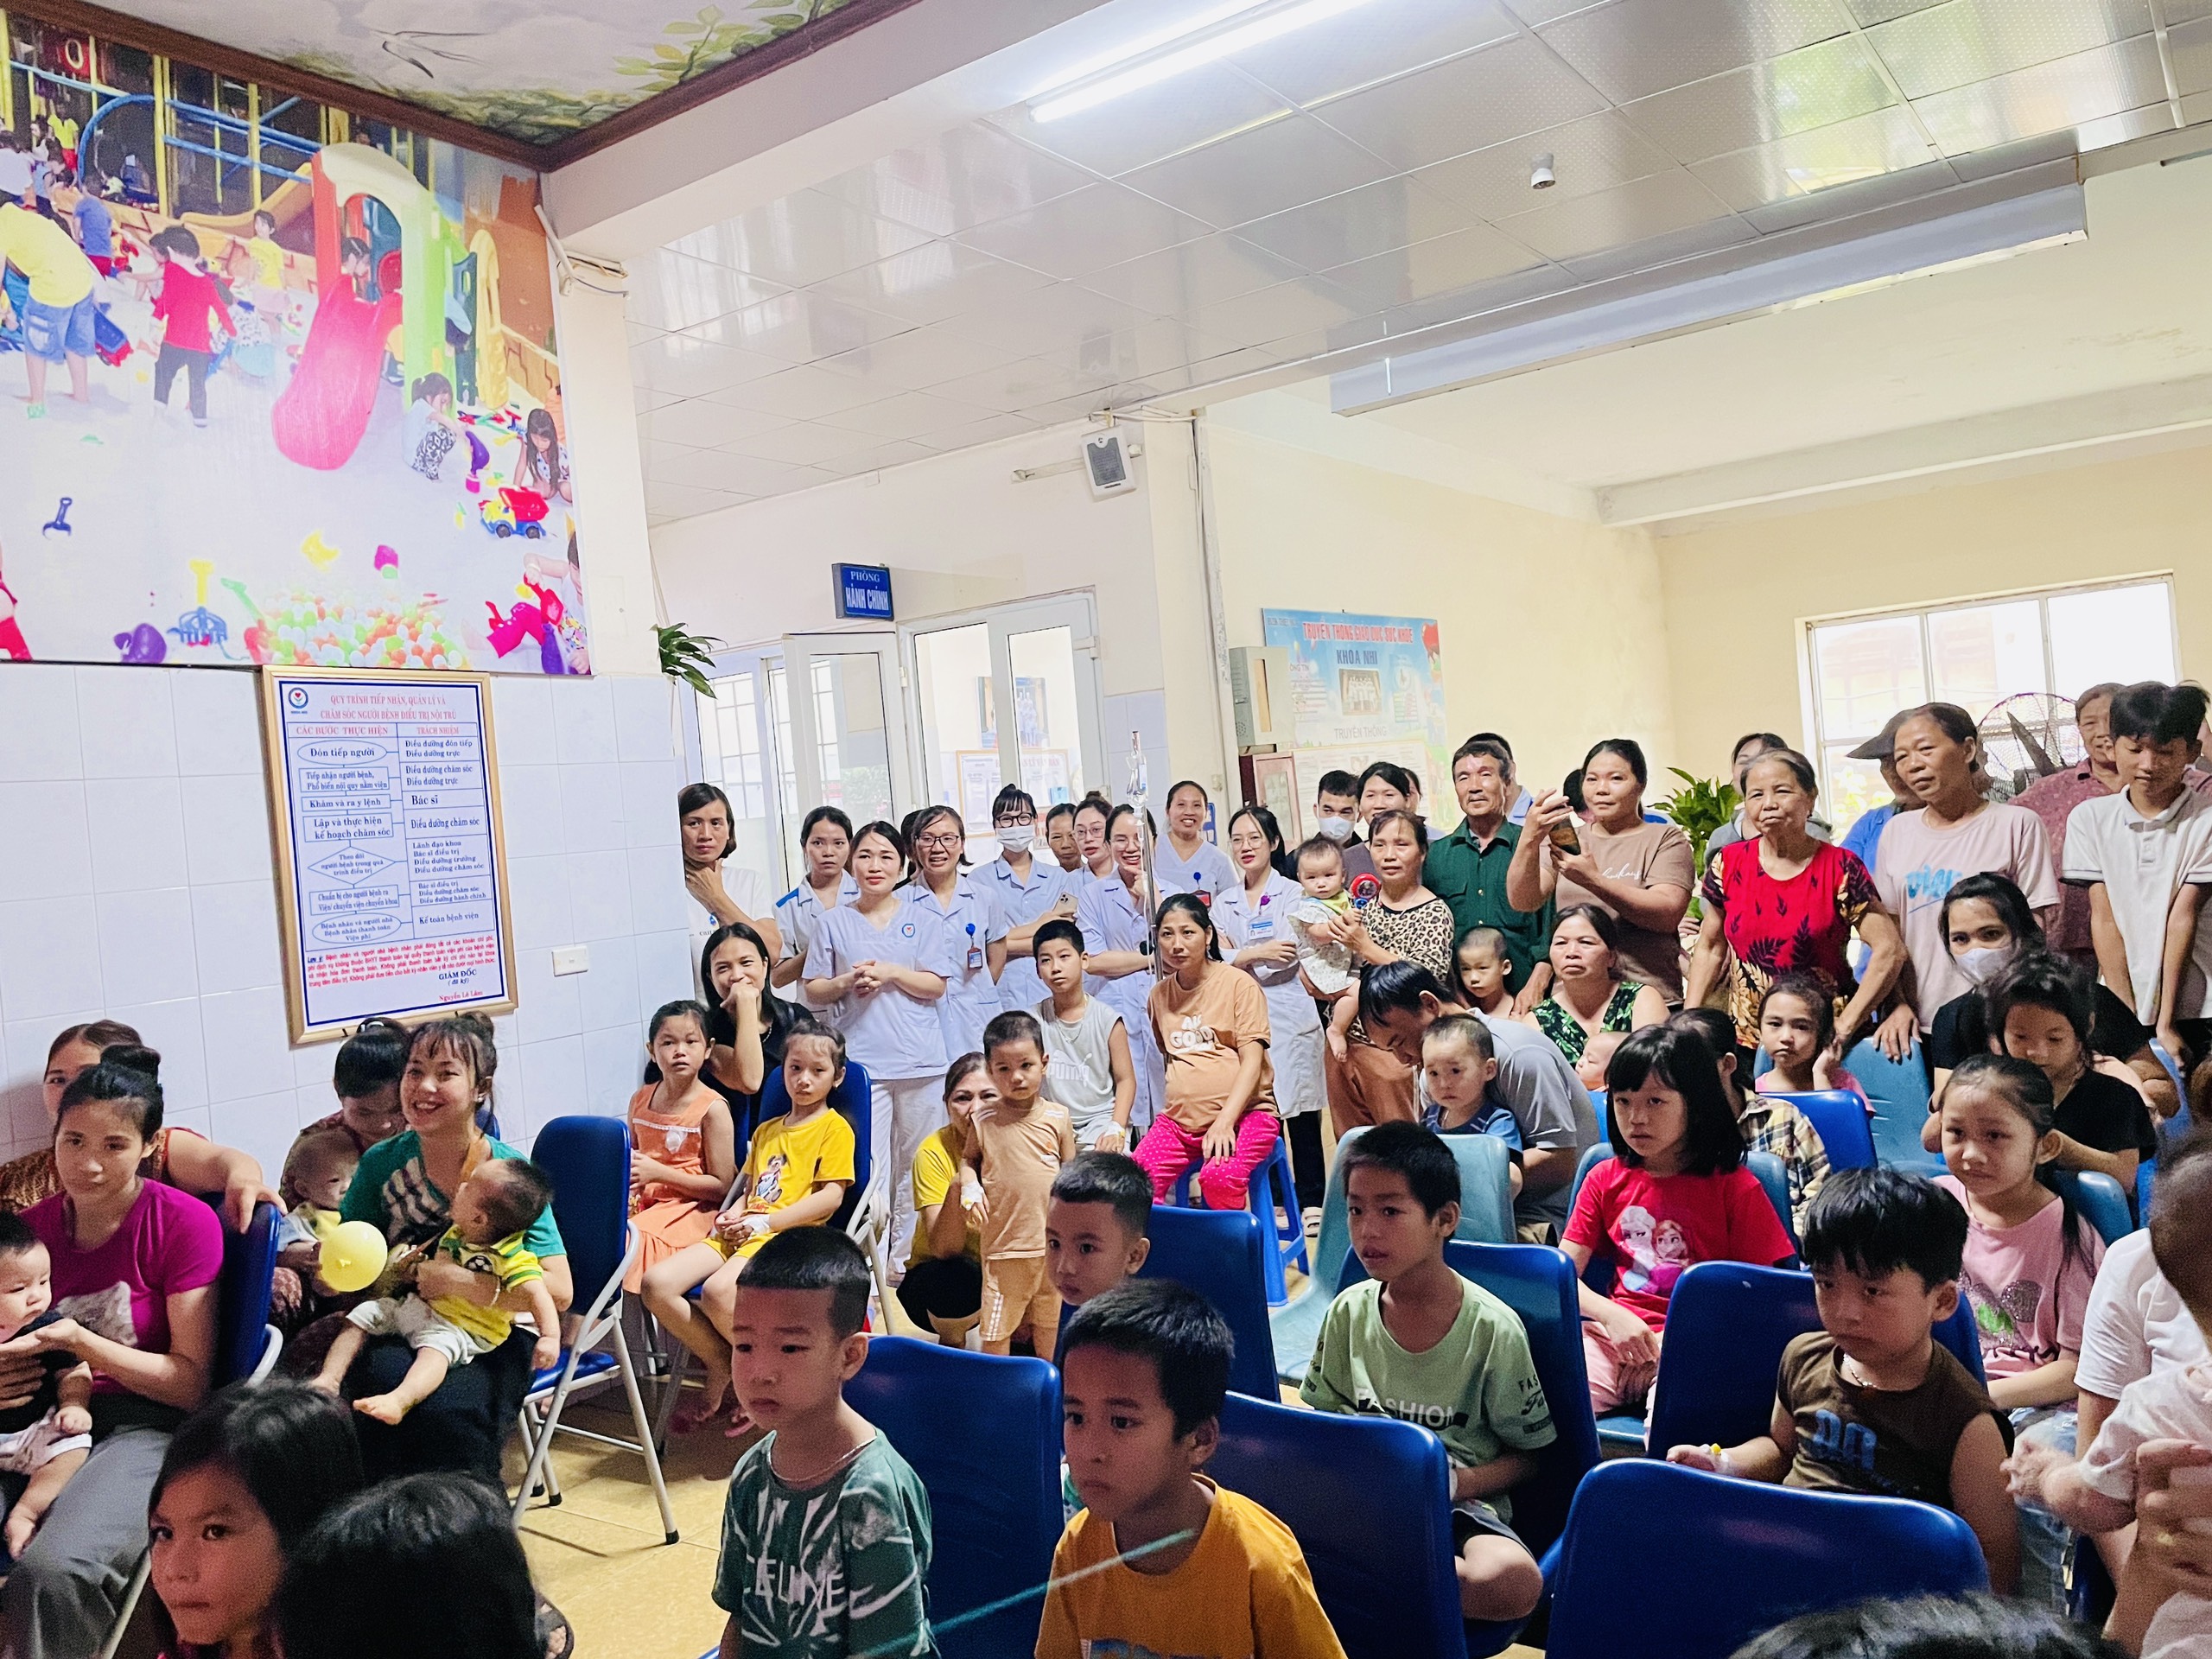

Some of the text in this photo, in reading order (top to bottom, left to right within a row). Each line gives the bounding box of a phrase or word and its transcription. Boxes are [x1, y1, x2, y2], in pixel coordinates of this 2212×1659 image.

[850, 570, 880, 582] PHÒNG
[845, 583, 889, 610] HÀNH CHÍNH
[1336, 650, 1378, 664] KHOA NHI
[330, 693, 446, 706] QUY TRÌNH TIẾP NHẬN, QUẢN LÝ VÀ
[320, 709, 341, 718] CHĂM
[341, 710, 356, 719] SÓC
[357, 710, 380, 719] NGƯỜI
[380, 710, 399, 720] BỆNH
[400, 709, 417, 719] ĐIỀU
[418, 711, 430, 721] TRỊ
[430, 710, 444, 720] NỘI
[342, 727, 366, 735] THỰC
[367, 726, 388, 734] HIỆN
[438, 727, 459, 735] NHIỆM
[1363, 725, 1388, 738] THÔNG
[330, 747, 347, 758] tiếp
[350, 747, 374, 757] người
[306, 770, 374, 780] Tiếp nhận người bệnh,
[405, 764, 422, 773] Điều
[422, 765, 442, 774] dưỡng
[307, 781, 319, 790] Phổ
[318, 780, 334, 790] biến
[357, 779, 372, 788] nằm
[406, 776, 422, 785] Điều
[423, 776, 443, 785] dưỡng
[364, 798, 380, 806] lệnh
[411, 794, 438, 804] Bác sĩ
[314, 818, 329, 829] Lập
[343, 817, 361, 827] thực
[364, 816, 381, 824] hiện
[410, 817, 426, 829] Điều
[428, 817, 448, 829] dưỡng
[449, 817, 467, 826] chăm
[315, 830, 325, 839] kế
[327, 829, 352, 841] hoạch
[353, 828, 376, 837] chăm
[438, 968, 477, 980] GIÁM ĐỐC
[1170, 1026, 1214, 1048] GOOD
